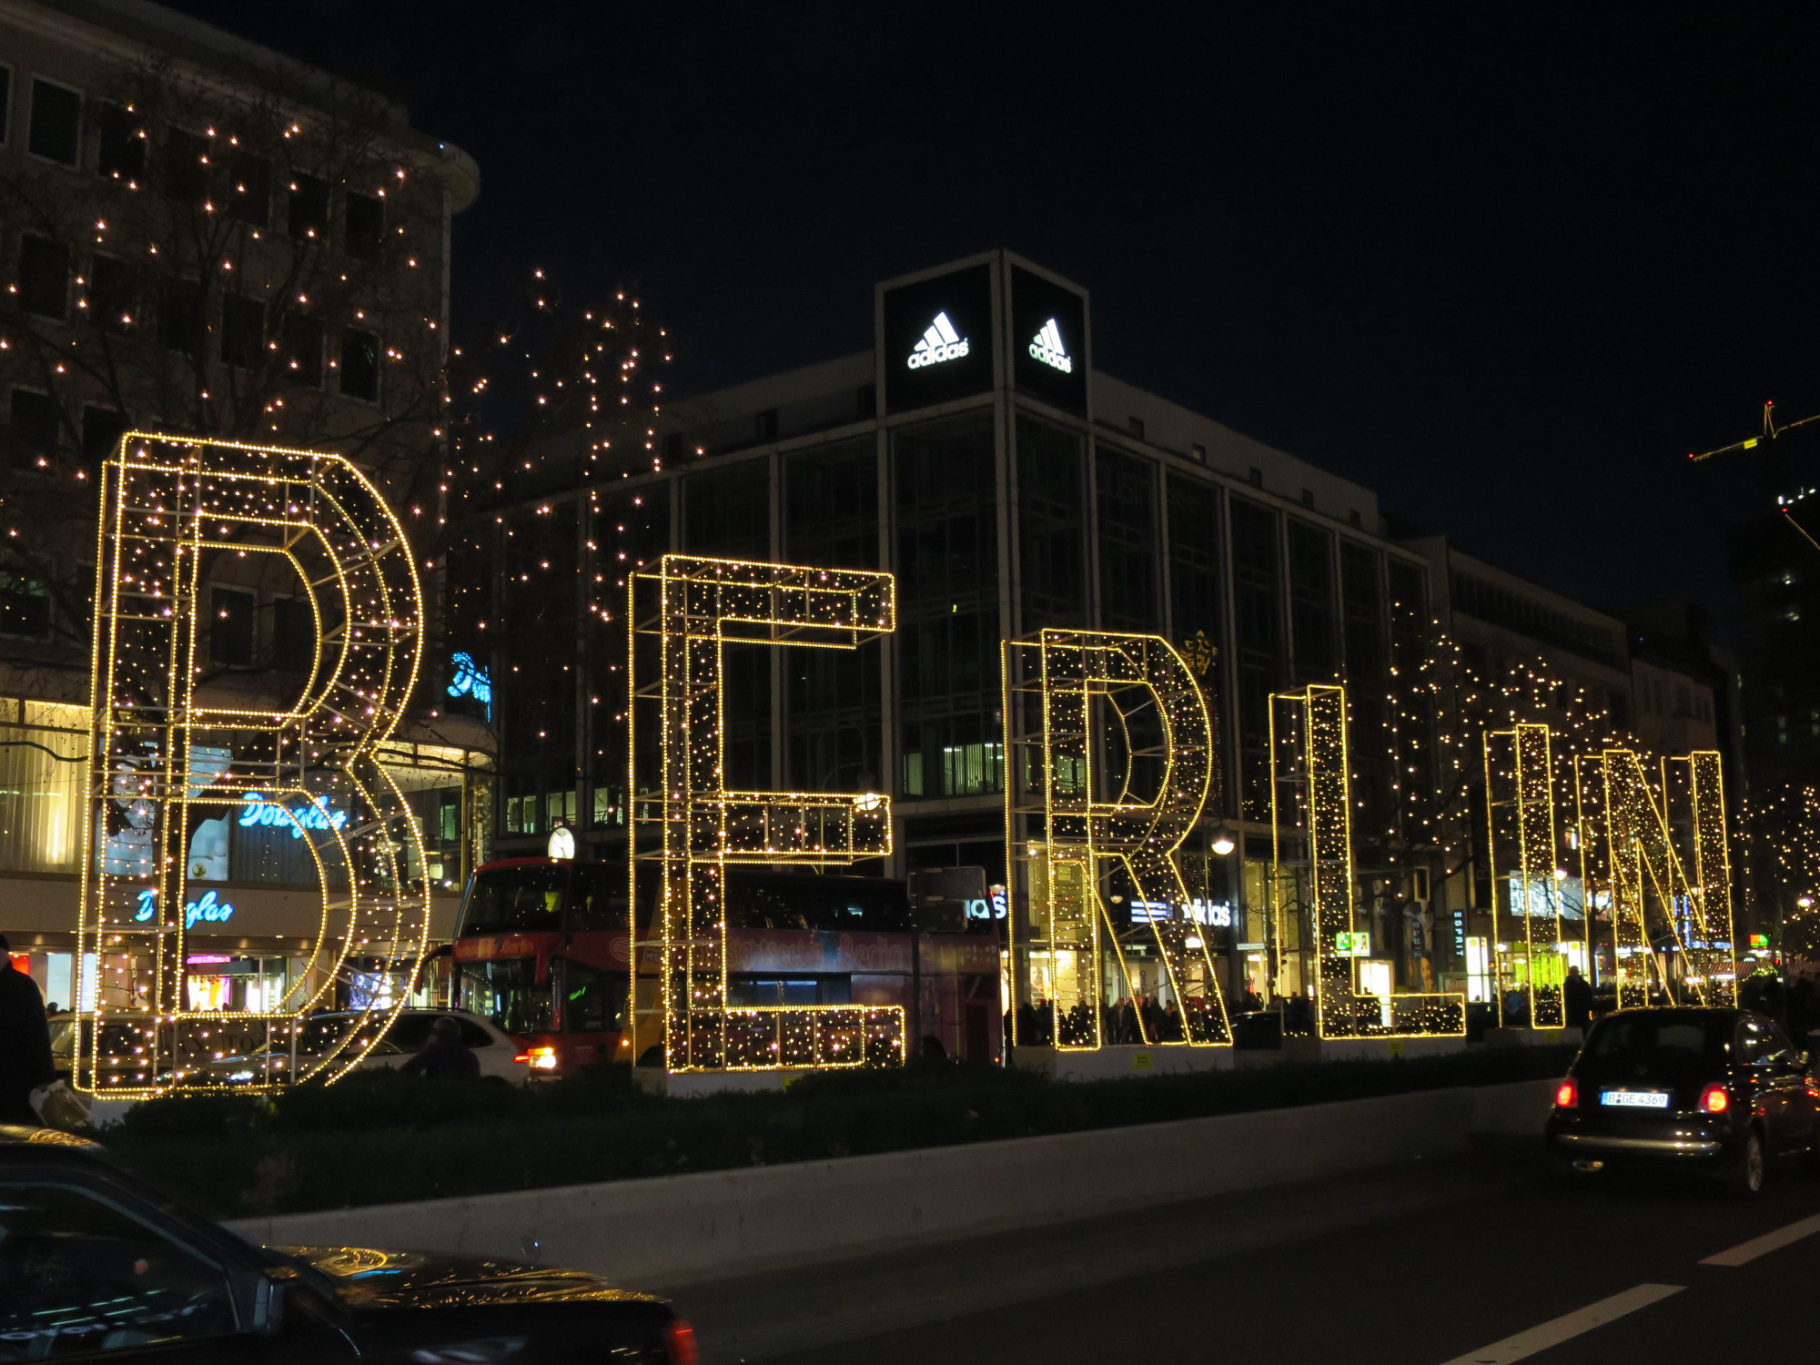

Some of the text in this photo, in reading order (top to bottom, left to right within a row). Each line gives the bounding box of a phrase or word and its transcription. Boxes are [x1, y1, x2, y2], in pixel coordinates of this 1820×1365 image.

[907, 340, 969, 369] adidas
[1029, 343, 1072, 374] adidas
[72, 428, 1738, 1102] BERLIN
[239, 791, 348, 839] Douglas
[135, 890, 234, 929] Dglas
[1453, 911, 1464, 956] ESPRIT
